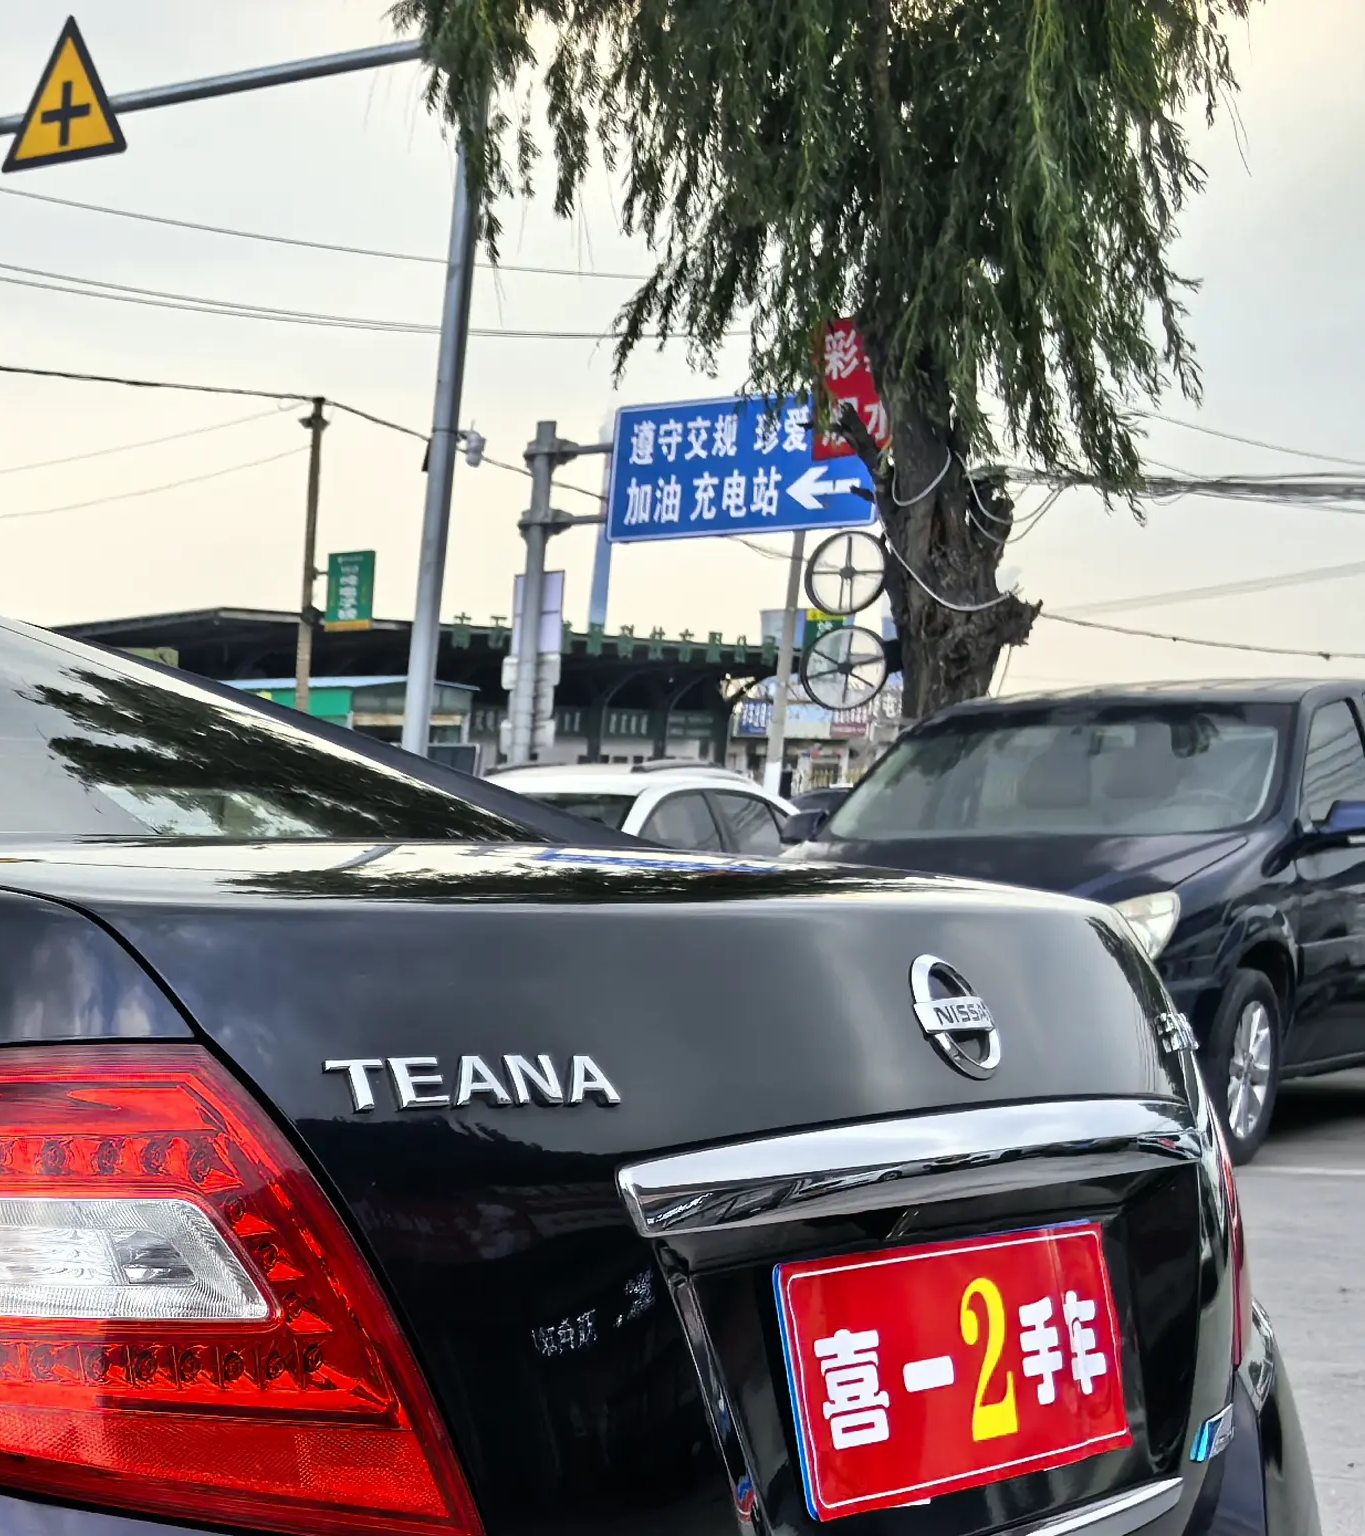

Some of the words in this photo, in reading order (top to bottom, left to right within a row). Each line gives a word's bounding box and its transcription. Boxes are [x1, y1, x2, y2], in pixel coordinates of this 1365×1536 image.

[629, 414, 738, 466] 遵守交规
[753, 405, 810, 455] 珍爱
[623, 474, 682, 526] 加油
[689, 465, 782, 521] 充电站
[322, 1054, 622, 1114] TEANA
